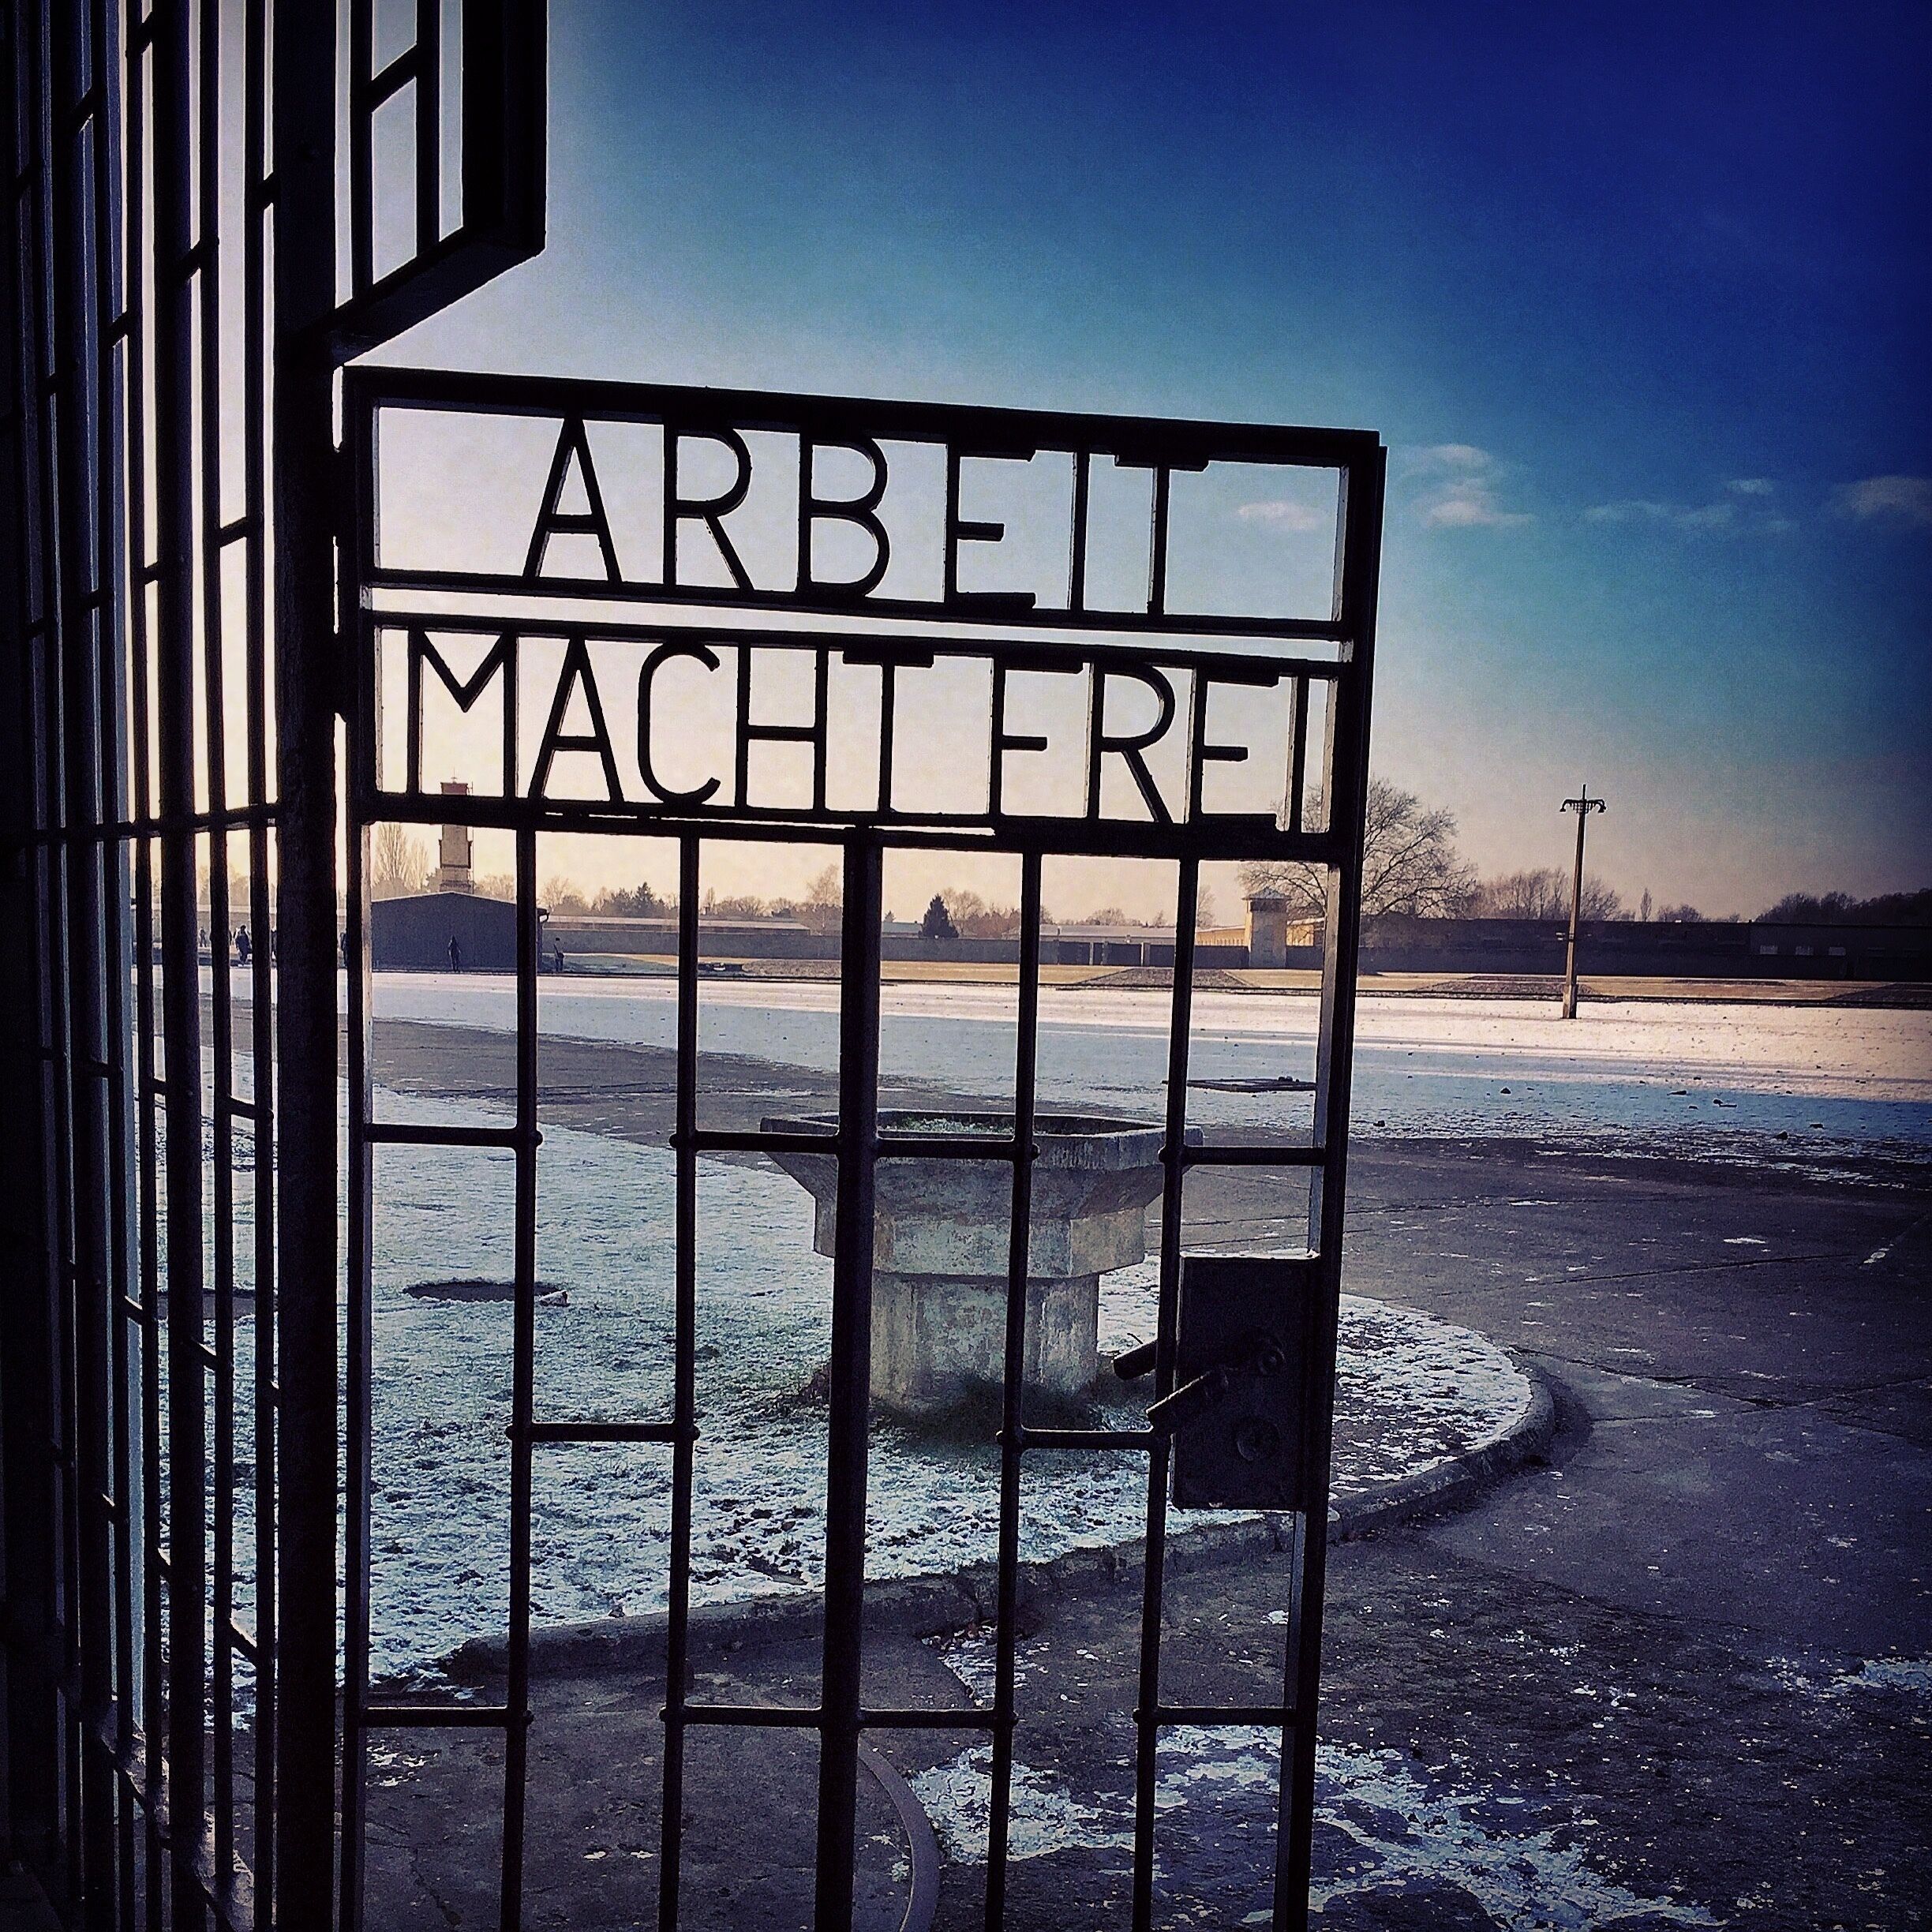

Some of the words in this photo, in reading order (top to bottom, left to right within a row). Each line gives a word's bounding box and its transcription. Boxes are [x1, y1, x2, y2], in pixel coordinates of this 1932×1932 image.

[524, 415, 1209, 614] ARBEIT
[406, 630, 934, 816] MACHT
[990, 652, 1304, 835] FREI
